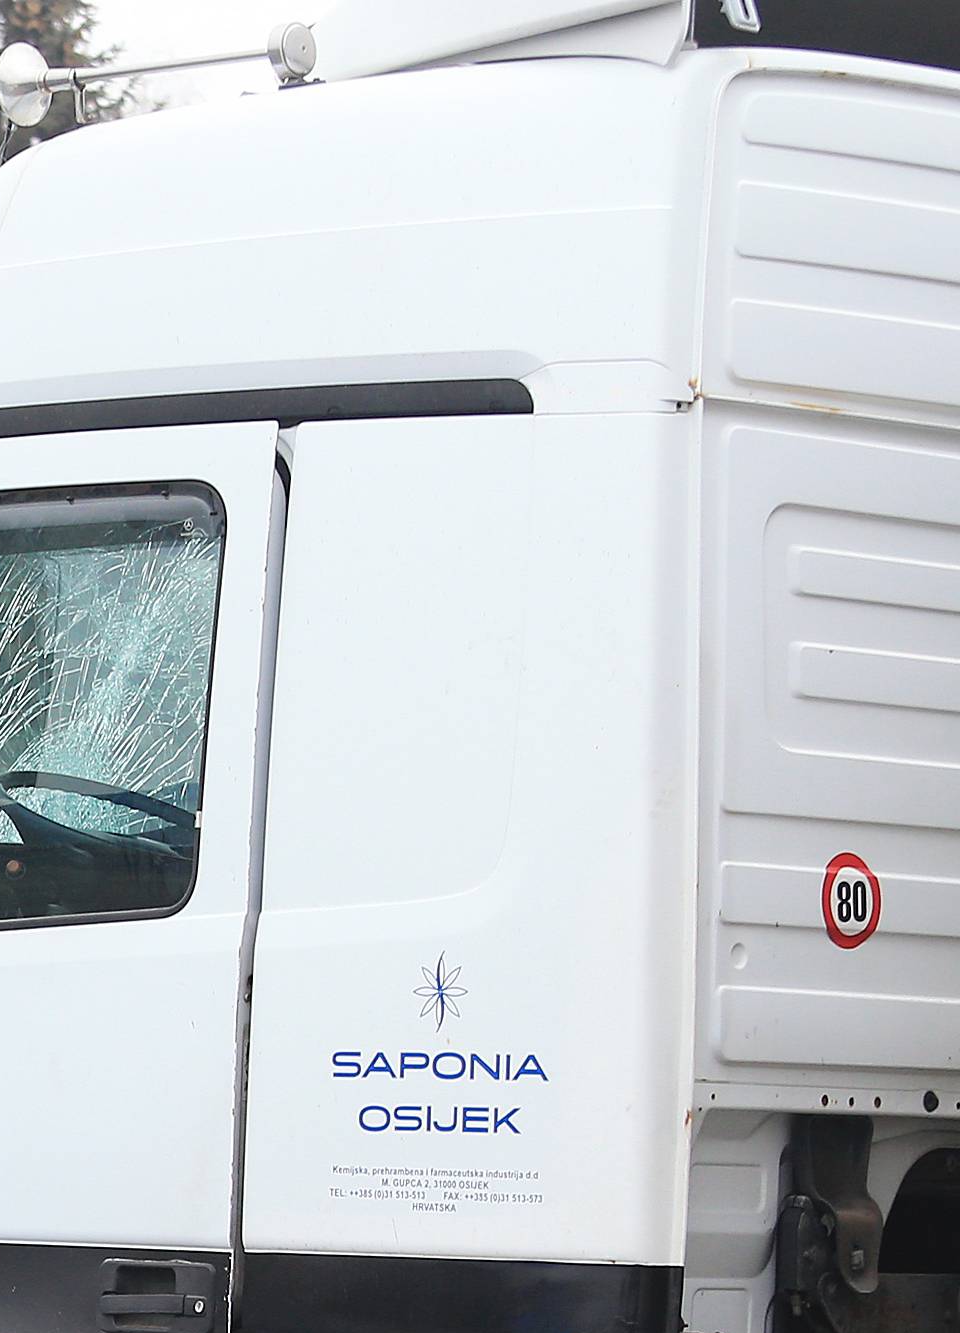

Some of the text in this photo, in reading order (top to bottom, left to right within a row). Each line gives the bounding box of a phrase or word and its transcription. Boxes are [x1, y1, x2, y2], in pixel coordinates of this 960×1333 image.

[837, 880, 867, 922] 80
[332, 1051, 549, 1081] SAPONIA
[358, 1105, 522, 1134] OSIJEK
[372, 1167, 424, 1176] prehrambena
[430, 1168, 483, 1178] farmaceutska
[486, 1169, 523, 1180] industrija
[381, 1178, 391, 1187] M.
[393, 1179, 422, 1188] GUPCA
[433, 1180, 457, 1189] 31000
[458, 1181, 489, 1190] OSIJEK
[443, 1191, 463, 1201] FAX:
[412, 1202, 457, 1212] HRVATSKA
